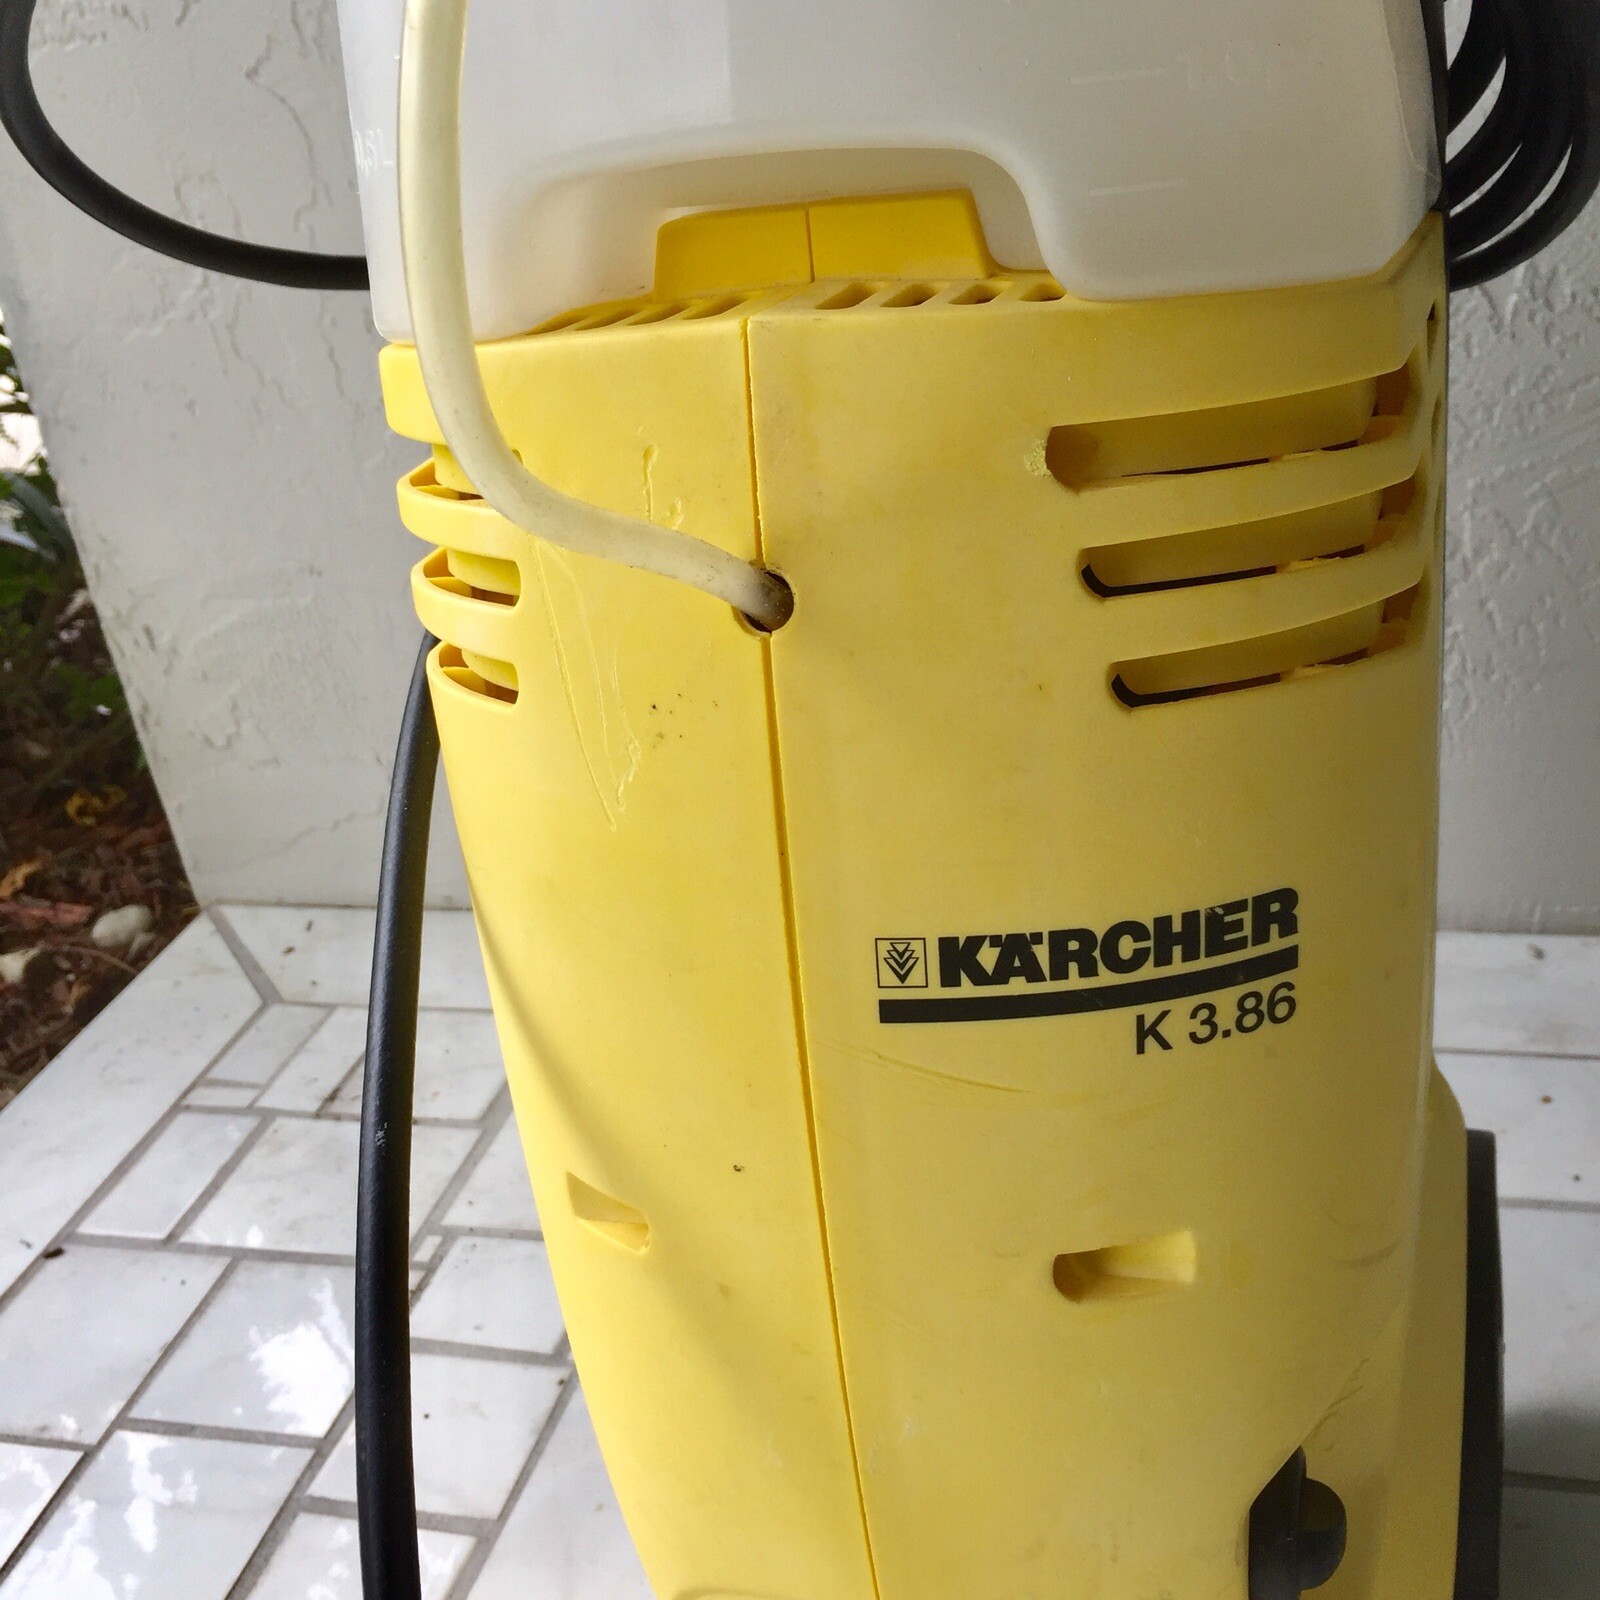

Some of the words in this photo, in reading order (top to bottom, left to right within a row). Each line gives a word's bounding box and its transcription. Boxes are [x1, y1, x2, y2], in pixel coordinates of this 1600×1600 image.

[938, 887, 1299, 988] KÄRCHER
[1136, 1009, 1173, 1055] K
[1188, 981, 1297, 1045] 3.86
